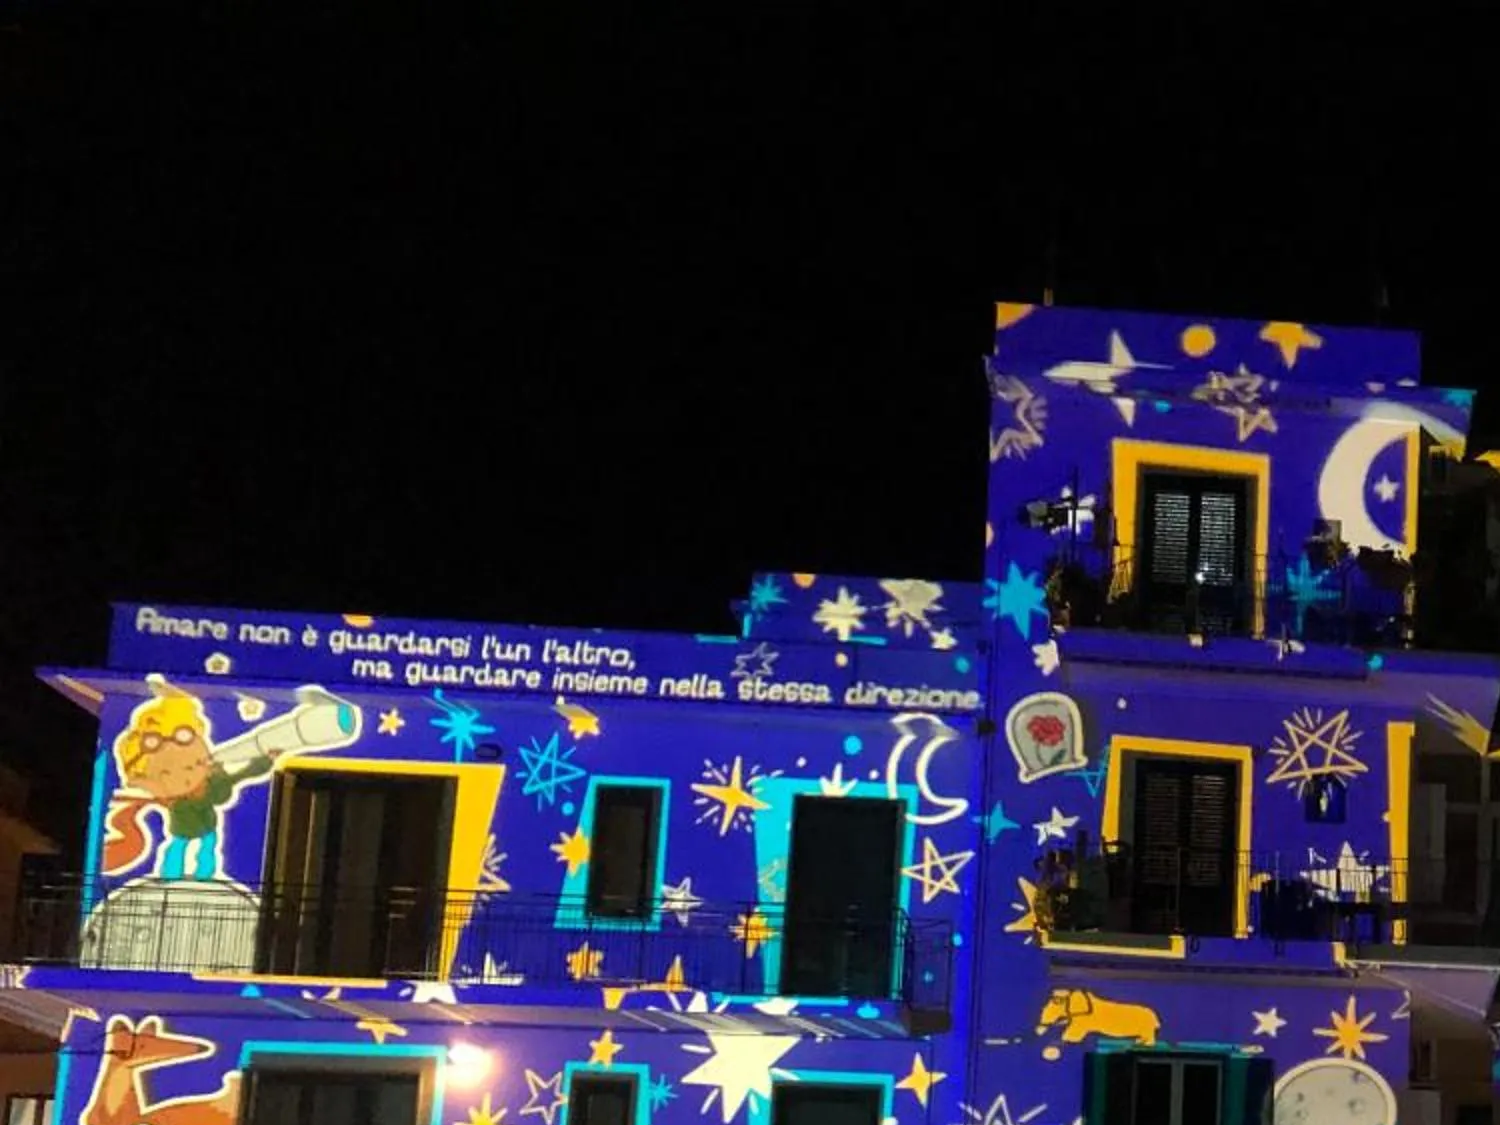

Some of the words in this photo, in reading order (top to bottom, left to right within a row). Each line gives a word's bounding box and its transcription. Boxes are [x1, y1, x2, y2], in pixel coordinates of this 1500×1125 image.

[136, 606, 229, 640] Amare
[239, 622, 291, 646] non
[301, 623, 319, 647] è
[328, 628, 473, 657] guardarsi
[481, 634, 532, 662] l'un
[541, 638, 637, 671] l'altro,
[351, 657, 395, 680] ma
[404, 660, 542, 689] guardare
[551, 666, 649, 695] insieme
[659, 673, 726, 699] nella
[737, 674, 832, 704] stessa
